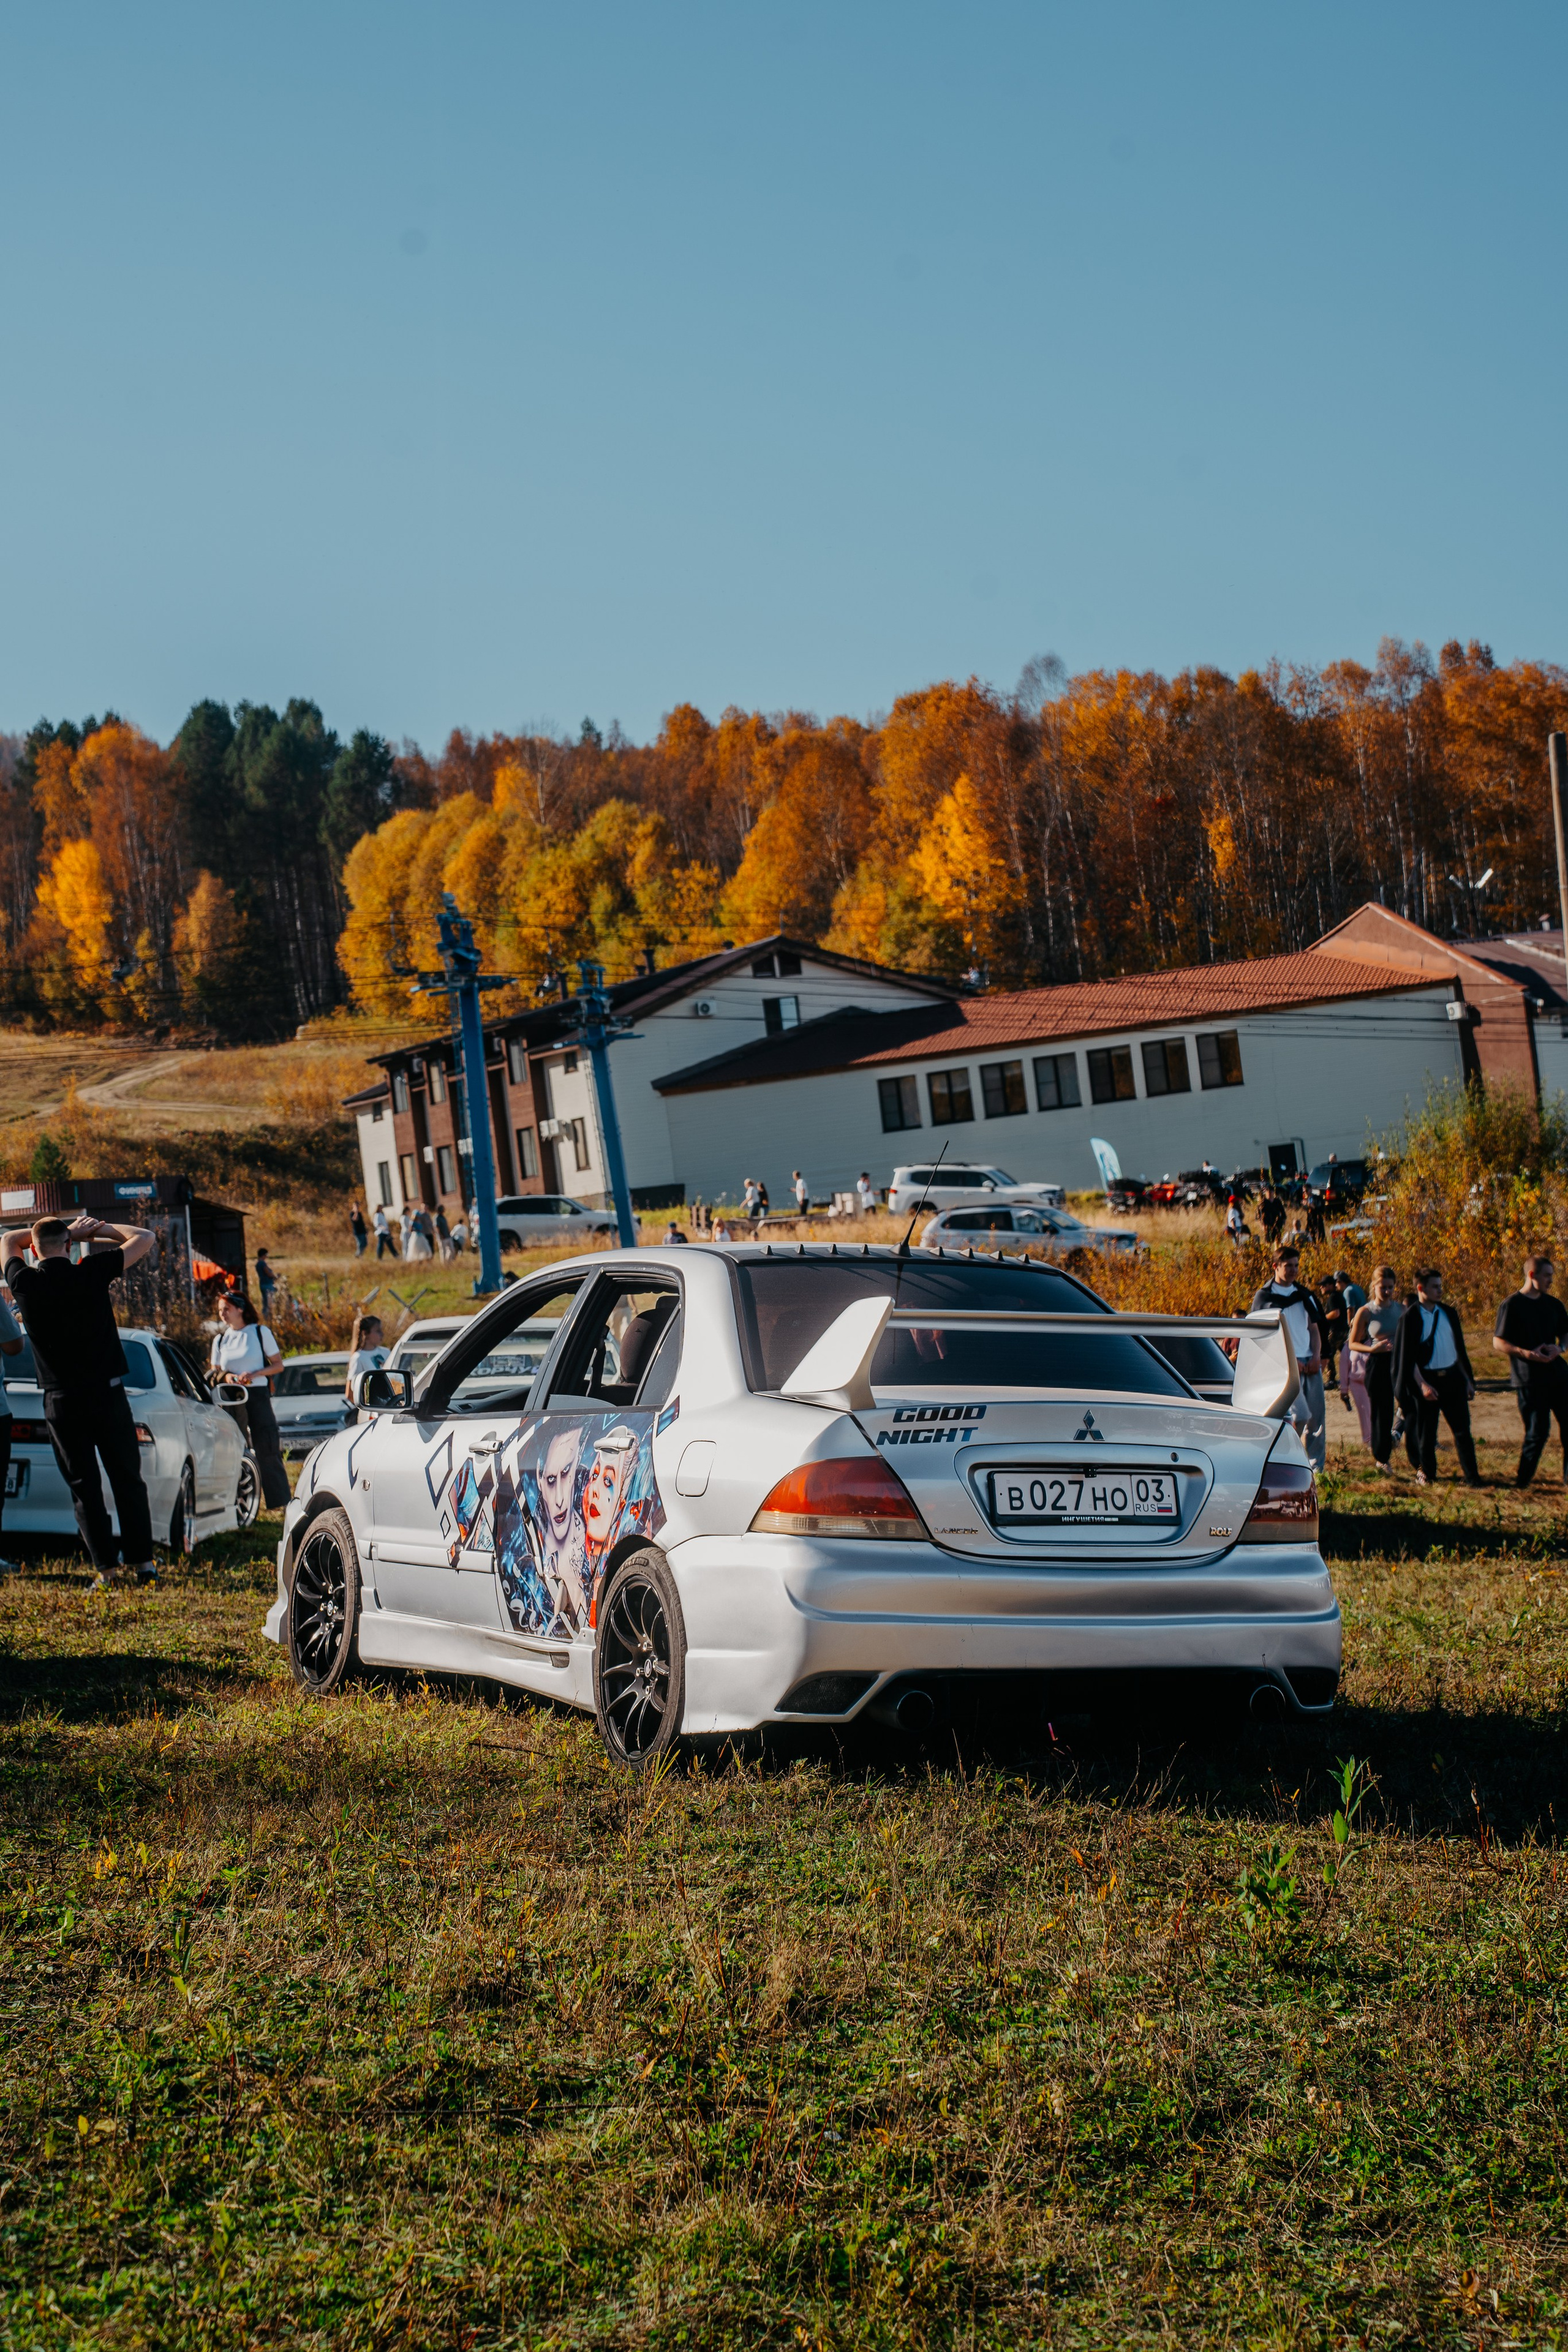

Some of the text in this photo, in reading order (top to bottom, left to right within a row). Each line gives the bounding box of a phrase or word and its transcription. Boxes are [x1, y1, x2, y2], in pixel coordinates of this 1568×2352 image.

[892, 1404, 987, 1423] GOOD
[876, 1427, 979, 1446] NIGHT
[1136, 1479, 1164, 1502] 03
[1136, 1504, 1156, 1512] RUS
[1210, 1527, 1232, 1537] ROLF
